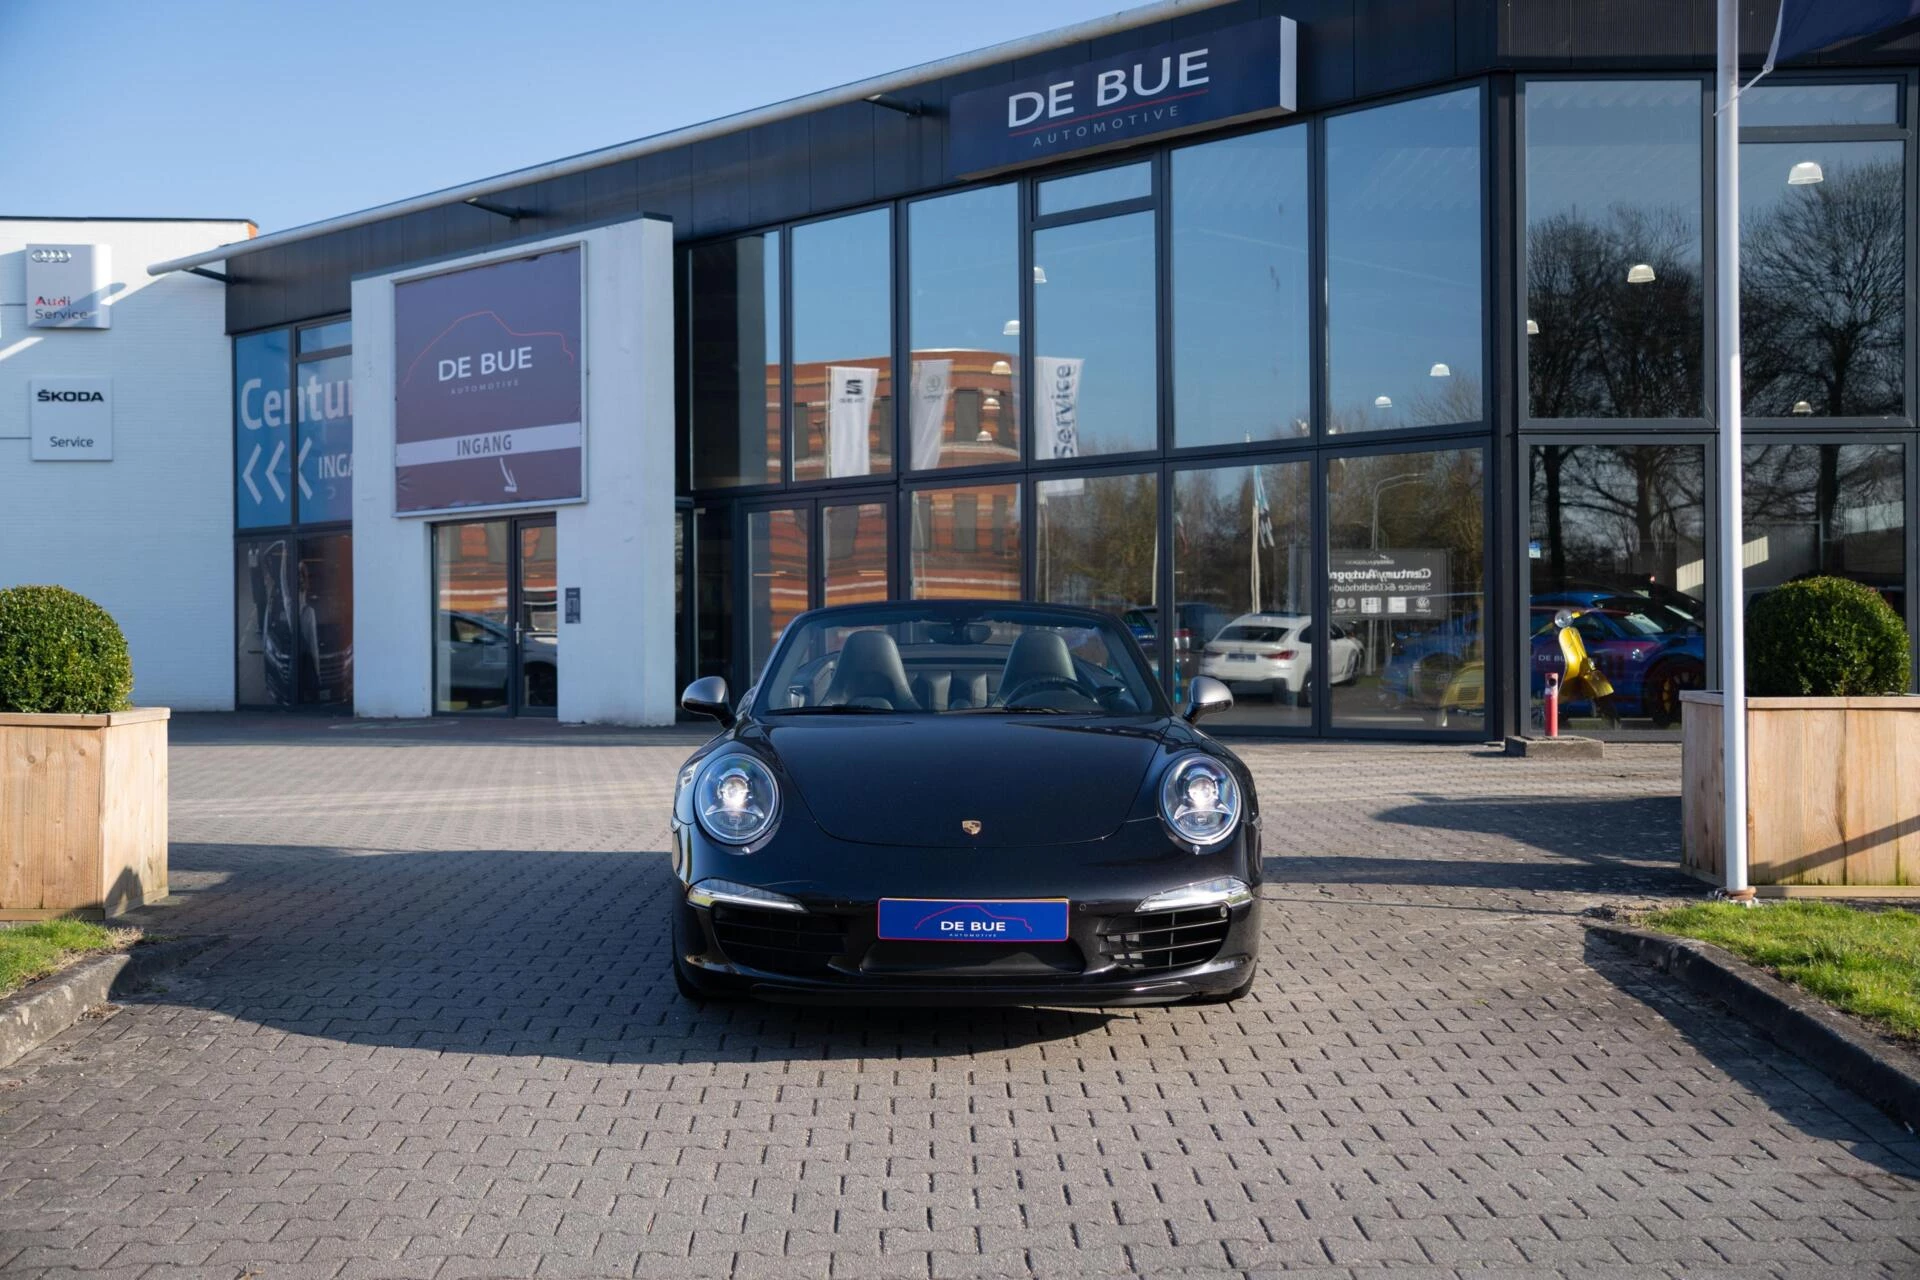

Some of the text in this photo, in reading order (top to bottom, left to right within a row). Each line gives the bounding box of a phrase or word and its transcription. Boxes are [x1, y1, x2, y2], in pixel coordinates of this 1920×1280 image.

[1008, 48, 1210, 128] DE BUE
[1033, 105, 1179, 147] AUTOMOTIVE
[35, 296, 71, 306] Audi
[35, 308, 89, 320] Service
[438, 346, 533, 382] DE BUE
[450, 379, 519, 395] AUTOMOTIVE
[37, 389, 105, 402] ŠKODA
[1051, 364, 1076, 459] Service
[49, 436, 95, 448] Service
[456, 434, 513, 457] INGANG
[1538, 654, 1552, 662] DE
[940, 921, 1006, 932] DE BUE
